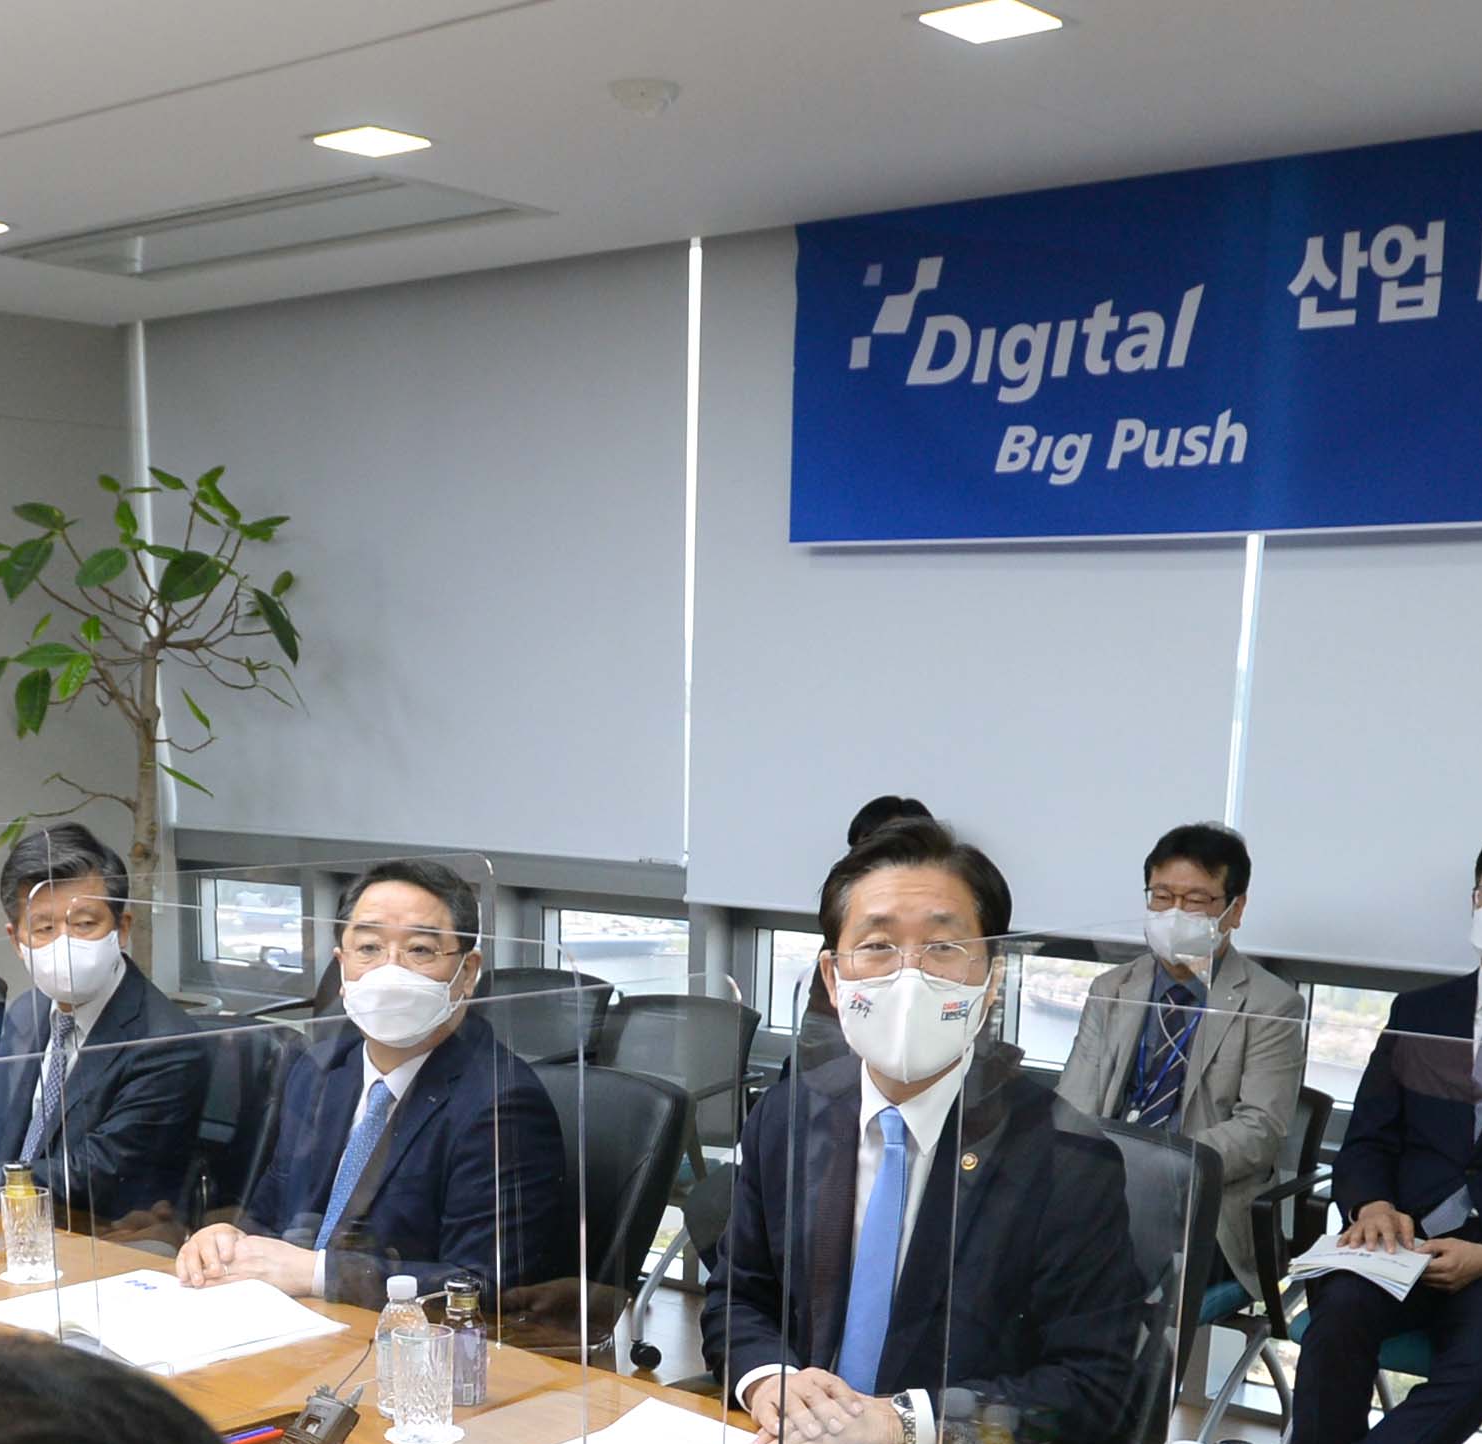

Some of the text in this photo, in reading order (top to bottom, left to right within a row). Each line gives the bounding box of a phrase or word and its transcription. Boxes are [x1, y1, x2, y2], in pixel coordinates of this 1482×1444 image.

[1287, 220, 1445, 331] 산업
[906, 283, 1205, 404] Digital
[994, 408, 1248, 486] Big Push
